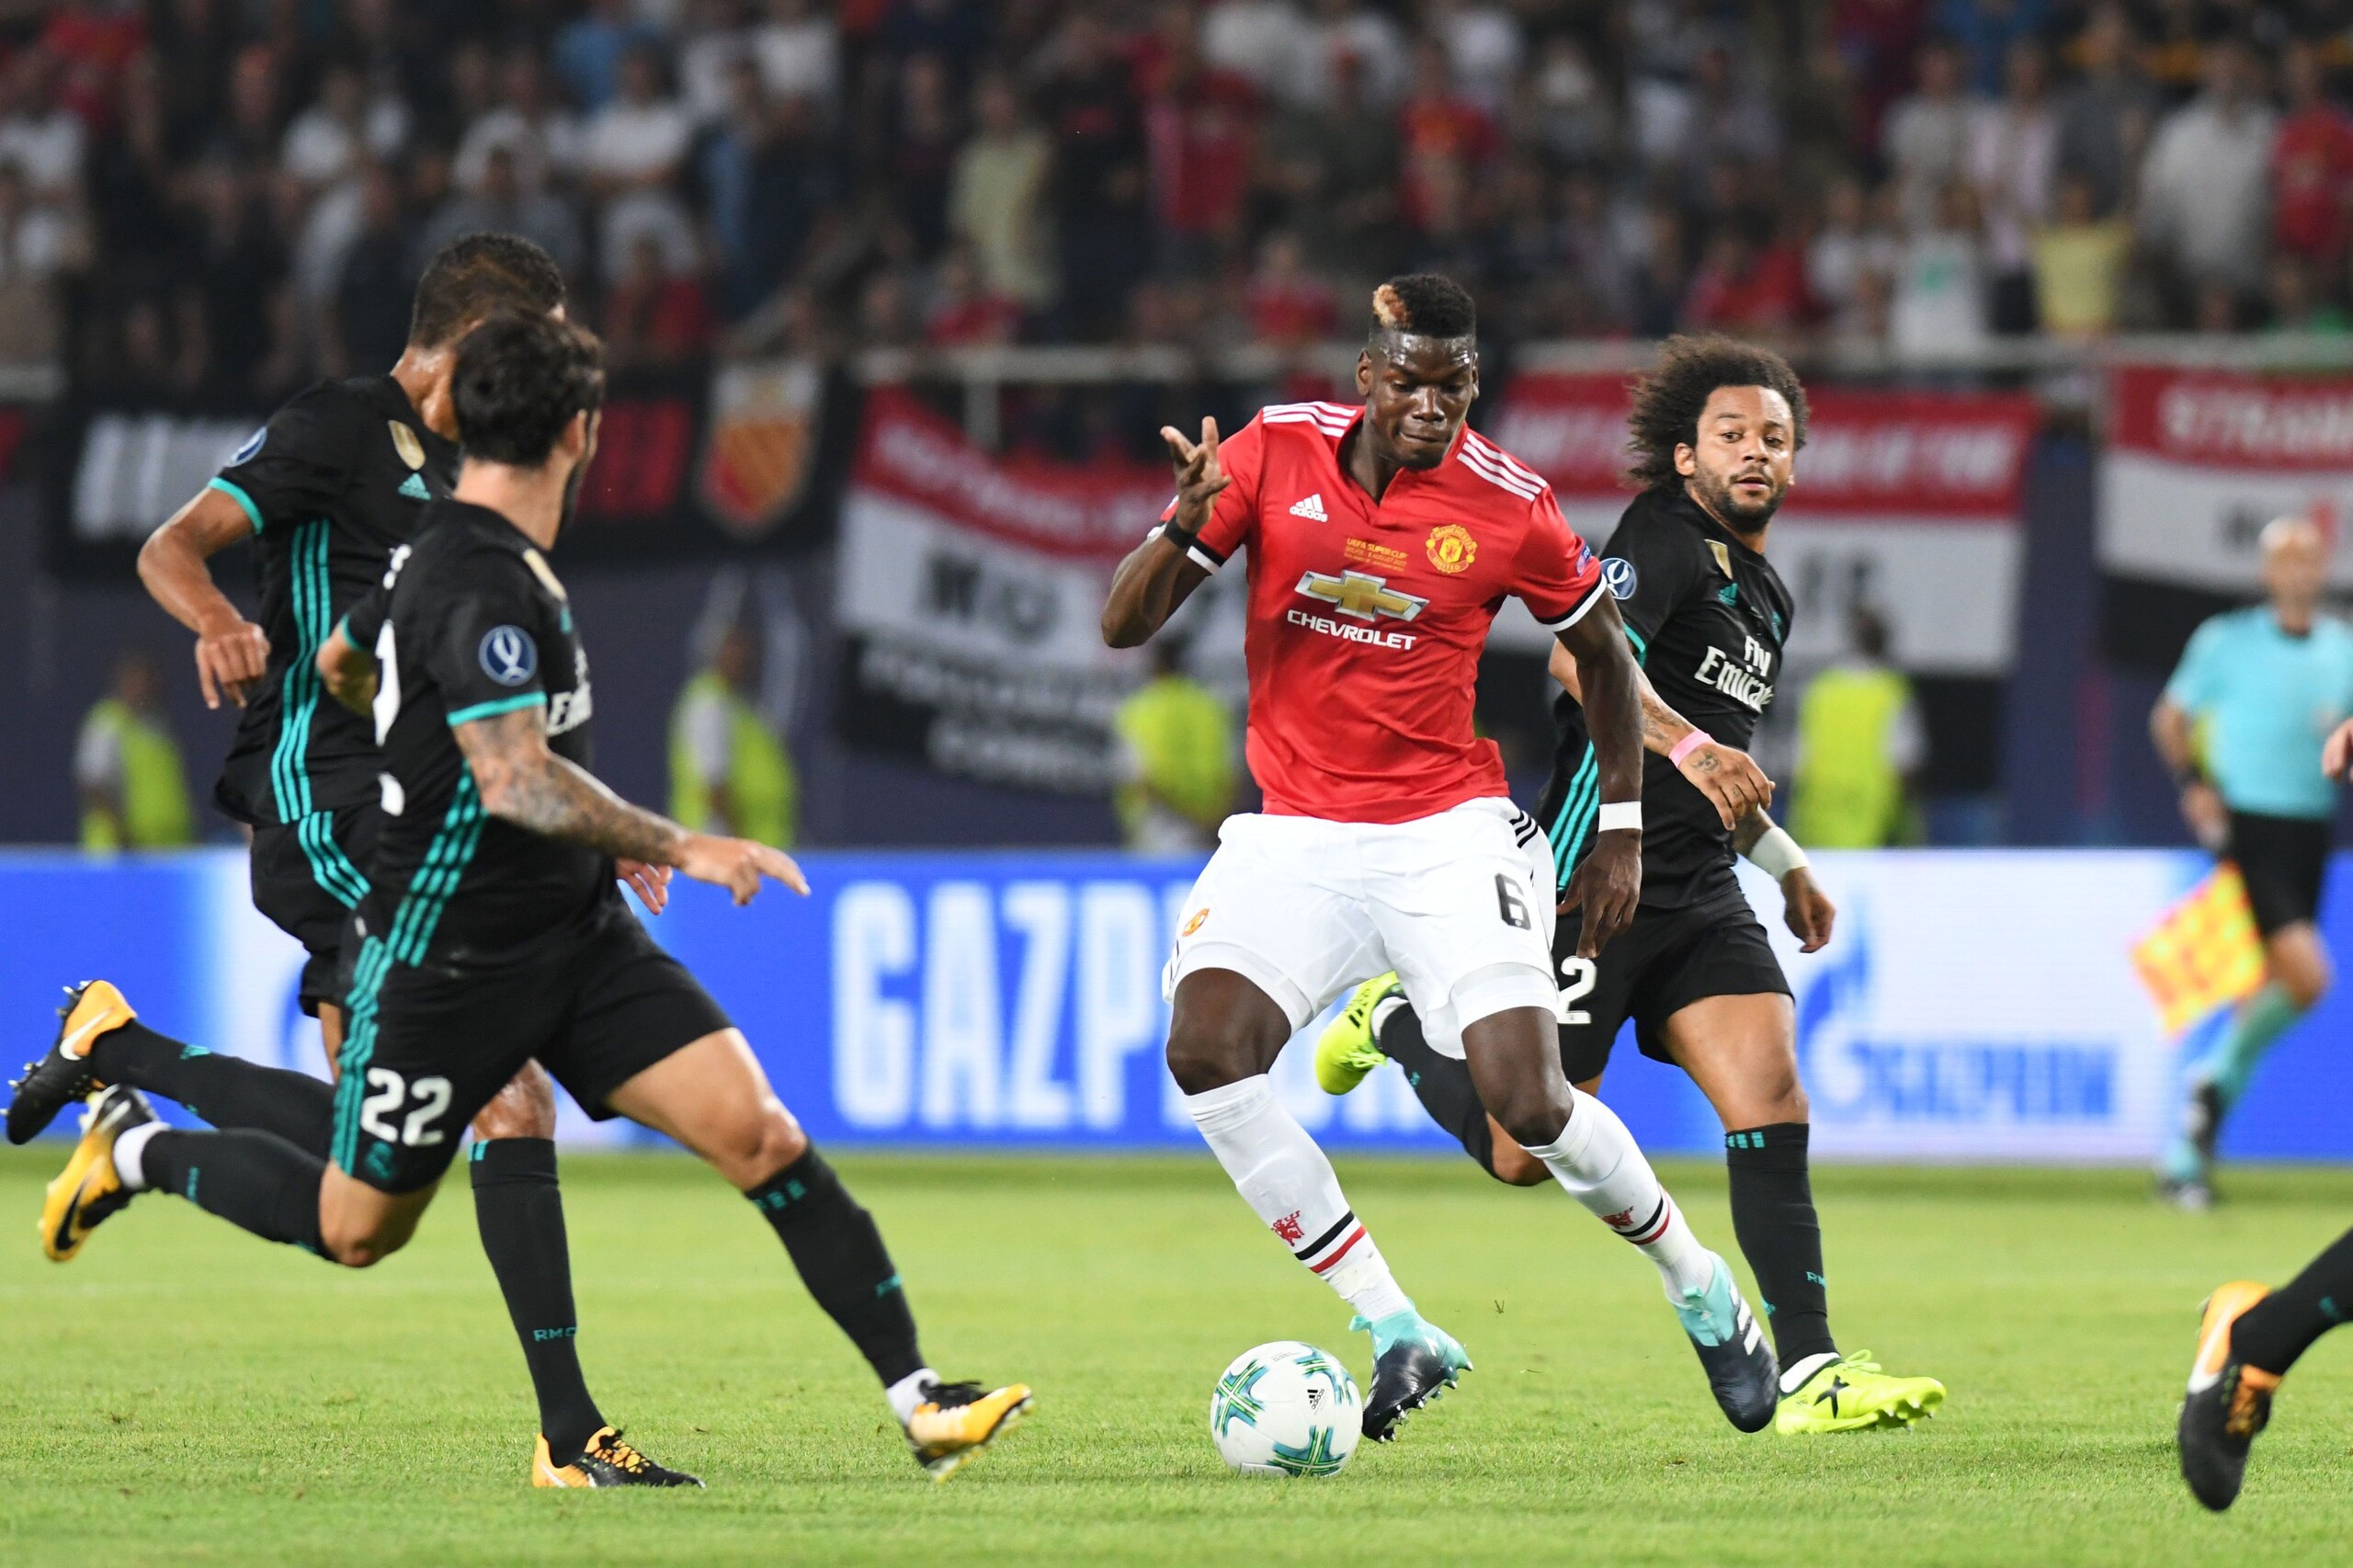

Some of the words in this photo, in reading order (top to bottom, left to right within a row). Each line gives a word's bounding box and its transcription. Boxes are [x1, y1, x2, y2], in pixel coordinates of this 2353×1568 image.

[1289, 505, 1328, 523] adidas
[1347, 537, 1367, 550] UEFA
[1367, 543, 1392, 555] SUPER
[1391, 550, 1409, 560] CUP
[1287, 608, 1417, 651] CHEVROLET
[1744, 635, 1772, 676] Fly
[1693, 645, 1775, 714] Emira
[1494, 872, 1532, 930] 6
[831, 880, 1432, 1130] GAZP
[360, 1066, 453, 1147] 22
[1311, 1388, 1325, 1410] adidas
